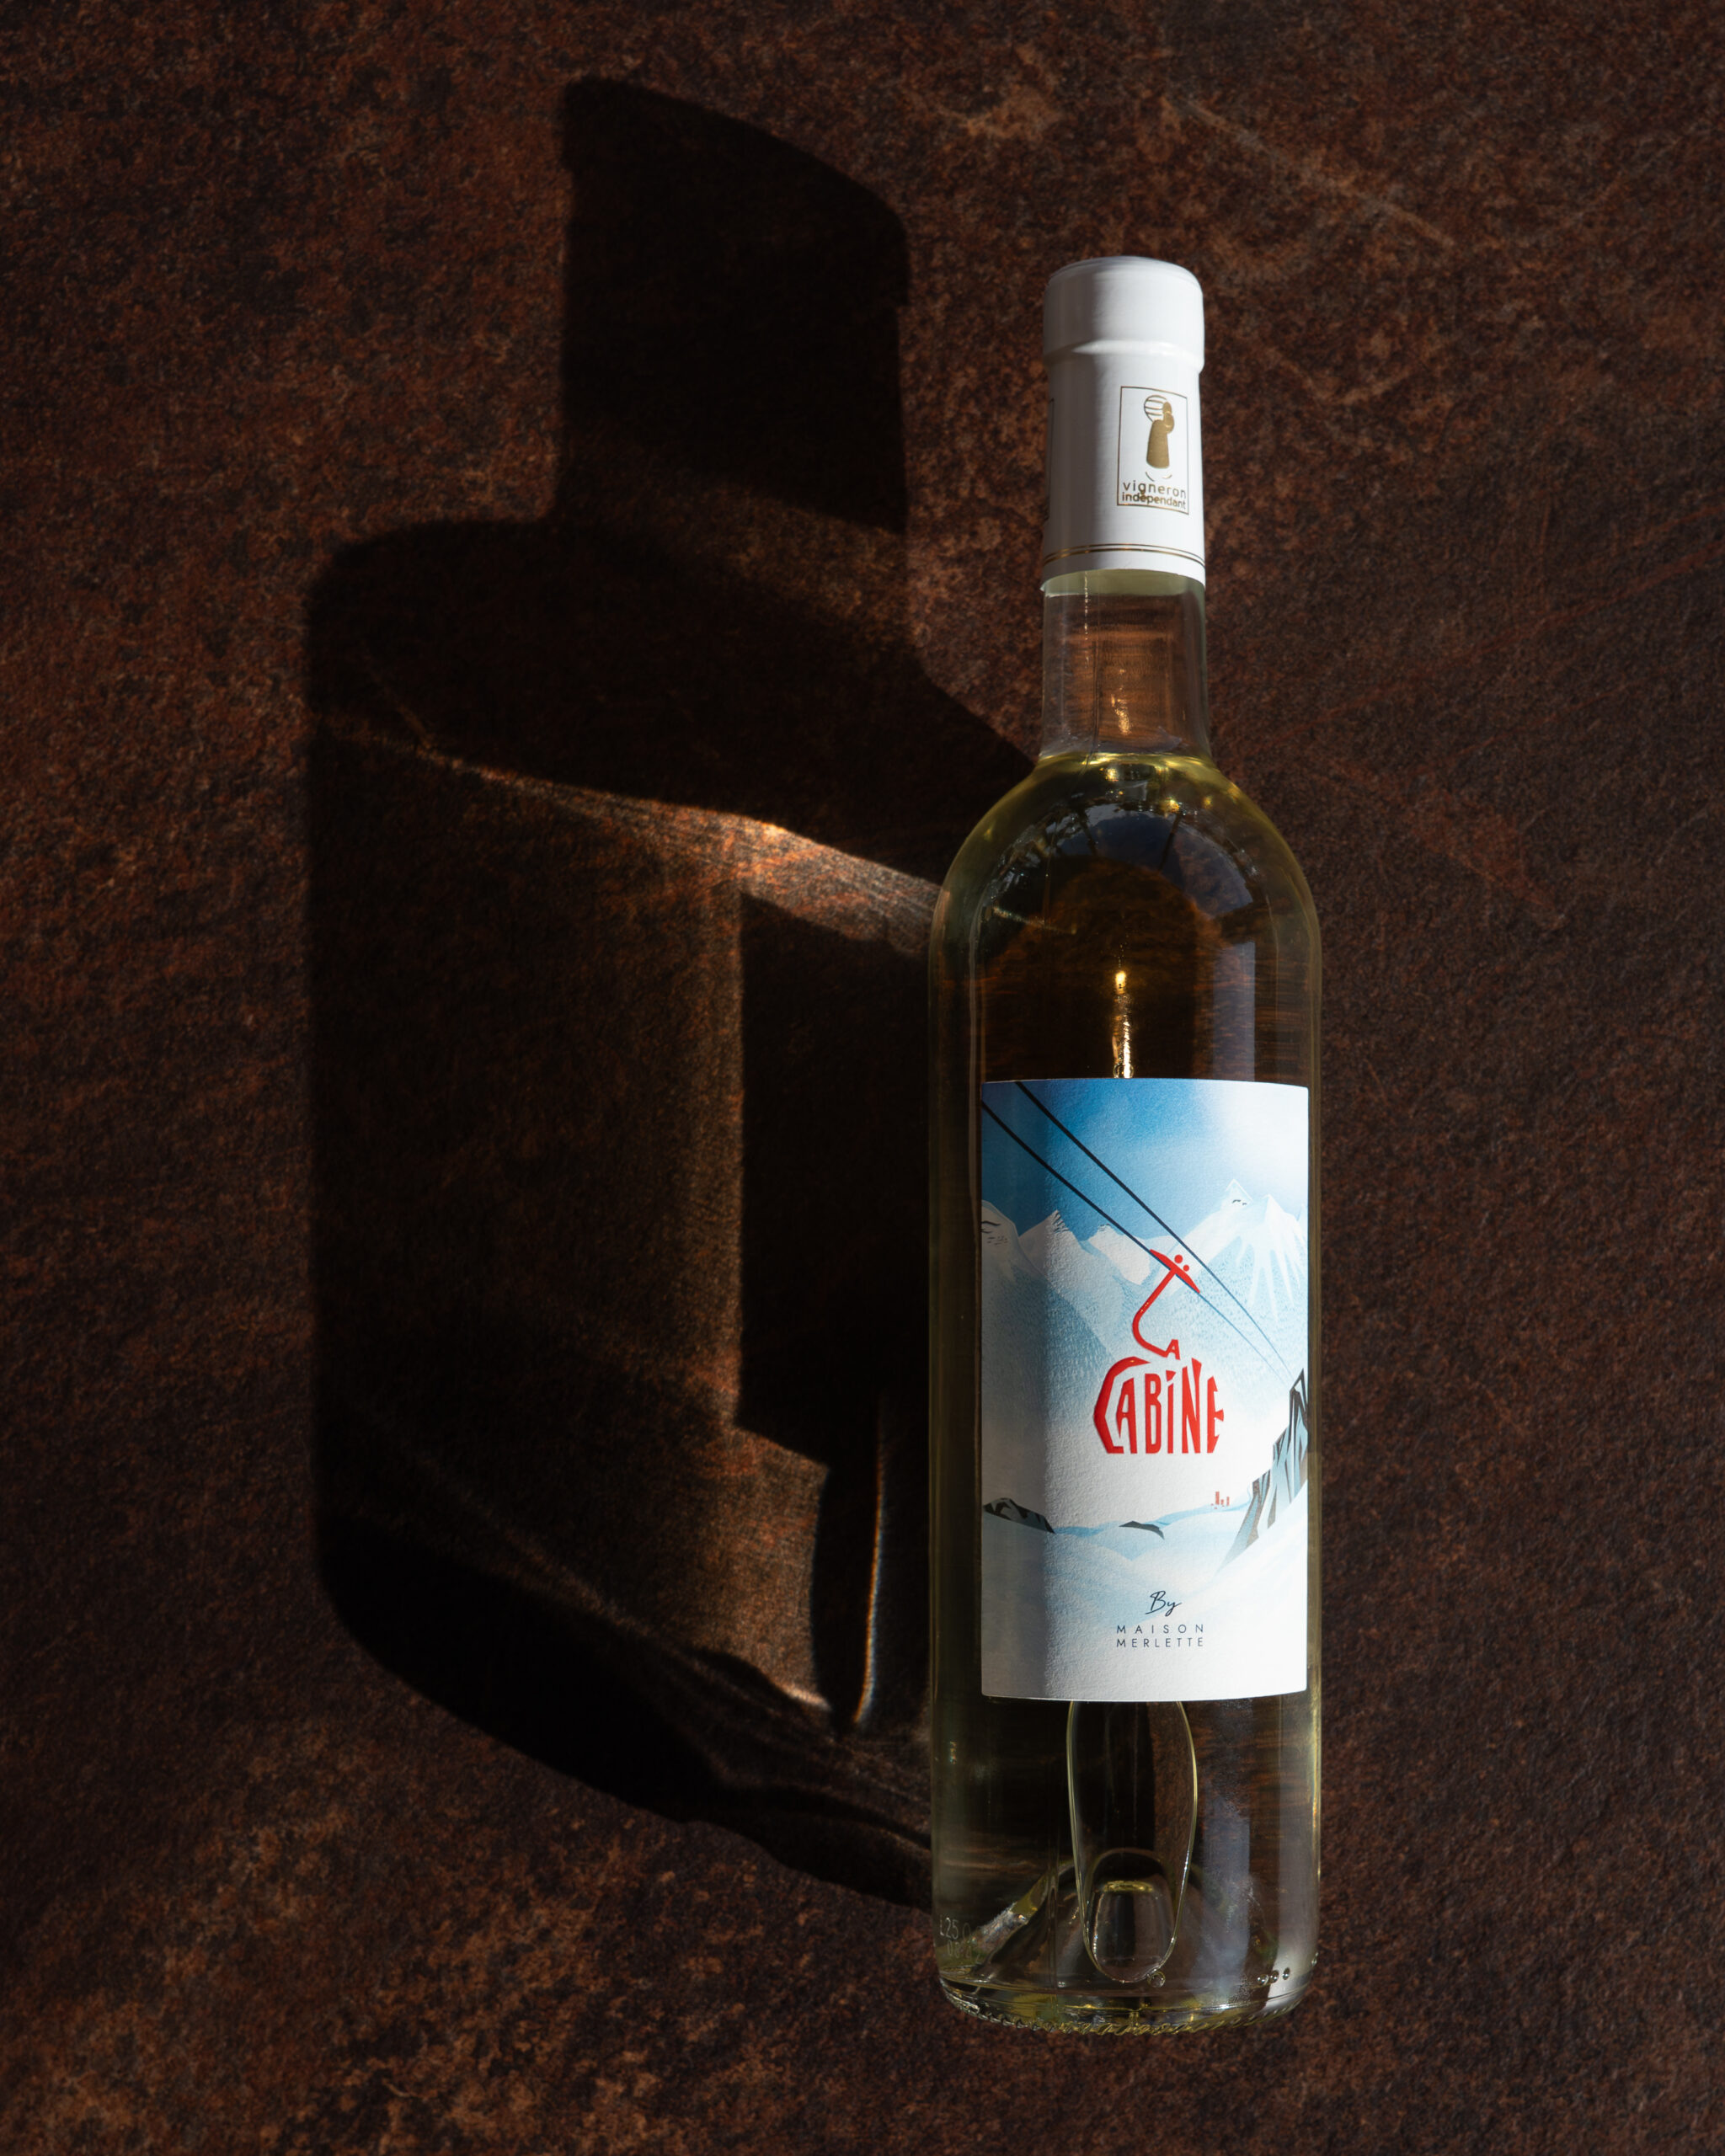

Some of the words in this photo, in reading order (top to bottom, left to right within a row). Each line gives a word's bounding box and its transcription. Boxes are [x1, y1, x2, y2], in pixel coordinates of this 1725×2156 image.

[1123, 480, 1186, 499] vigneron
[1146, 1590, 1183, 1617] By
[1117, 1624, 1204, 1634] MAISON
[1117, 1636, 1203, 1647] MERLETTE
